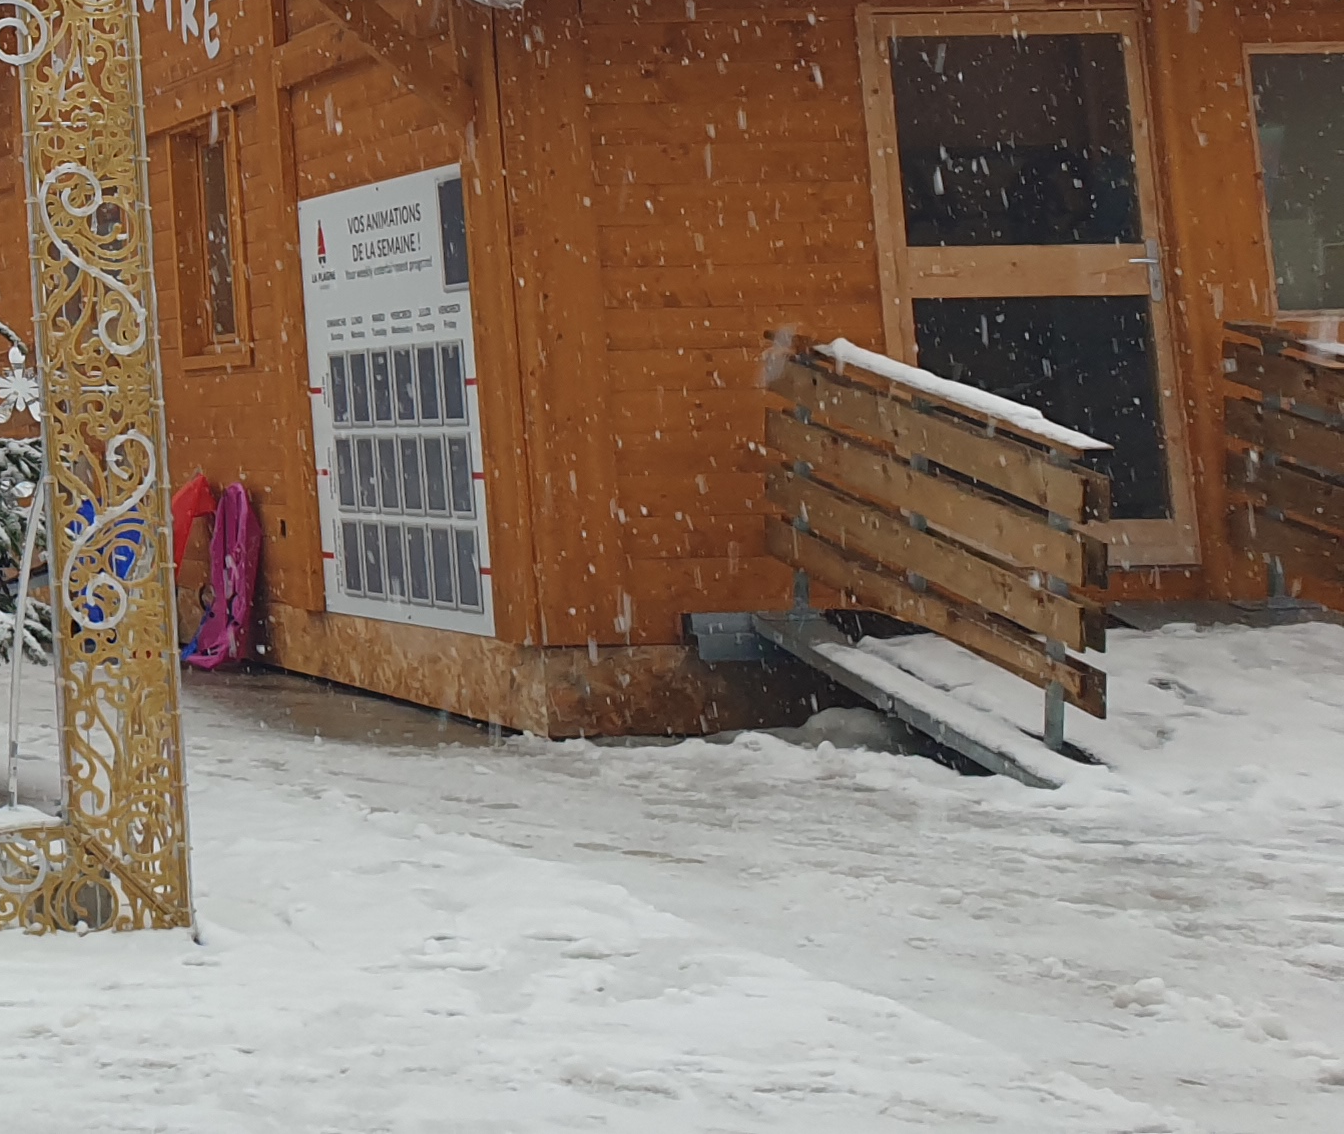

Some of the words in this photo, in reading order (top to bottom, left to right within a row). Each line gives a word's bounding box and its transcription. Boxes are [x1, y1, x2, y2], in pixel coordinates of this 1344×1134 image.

[347, 215, 365, 234] VOS
[366, 203, 421, 232] ANIMATIONS
[352, 243, 364, 262] DE
[365, 240, 376, 260] LA
[377, 232, 416, 258] SEMAINE
